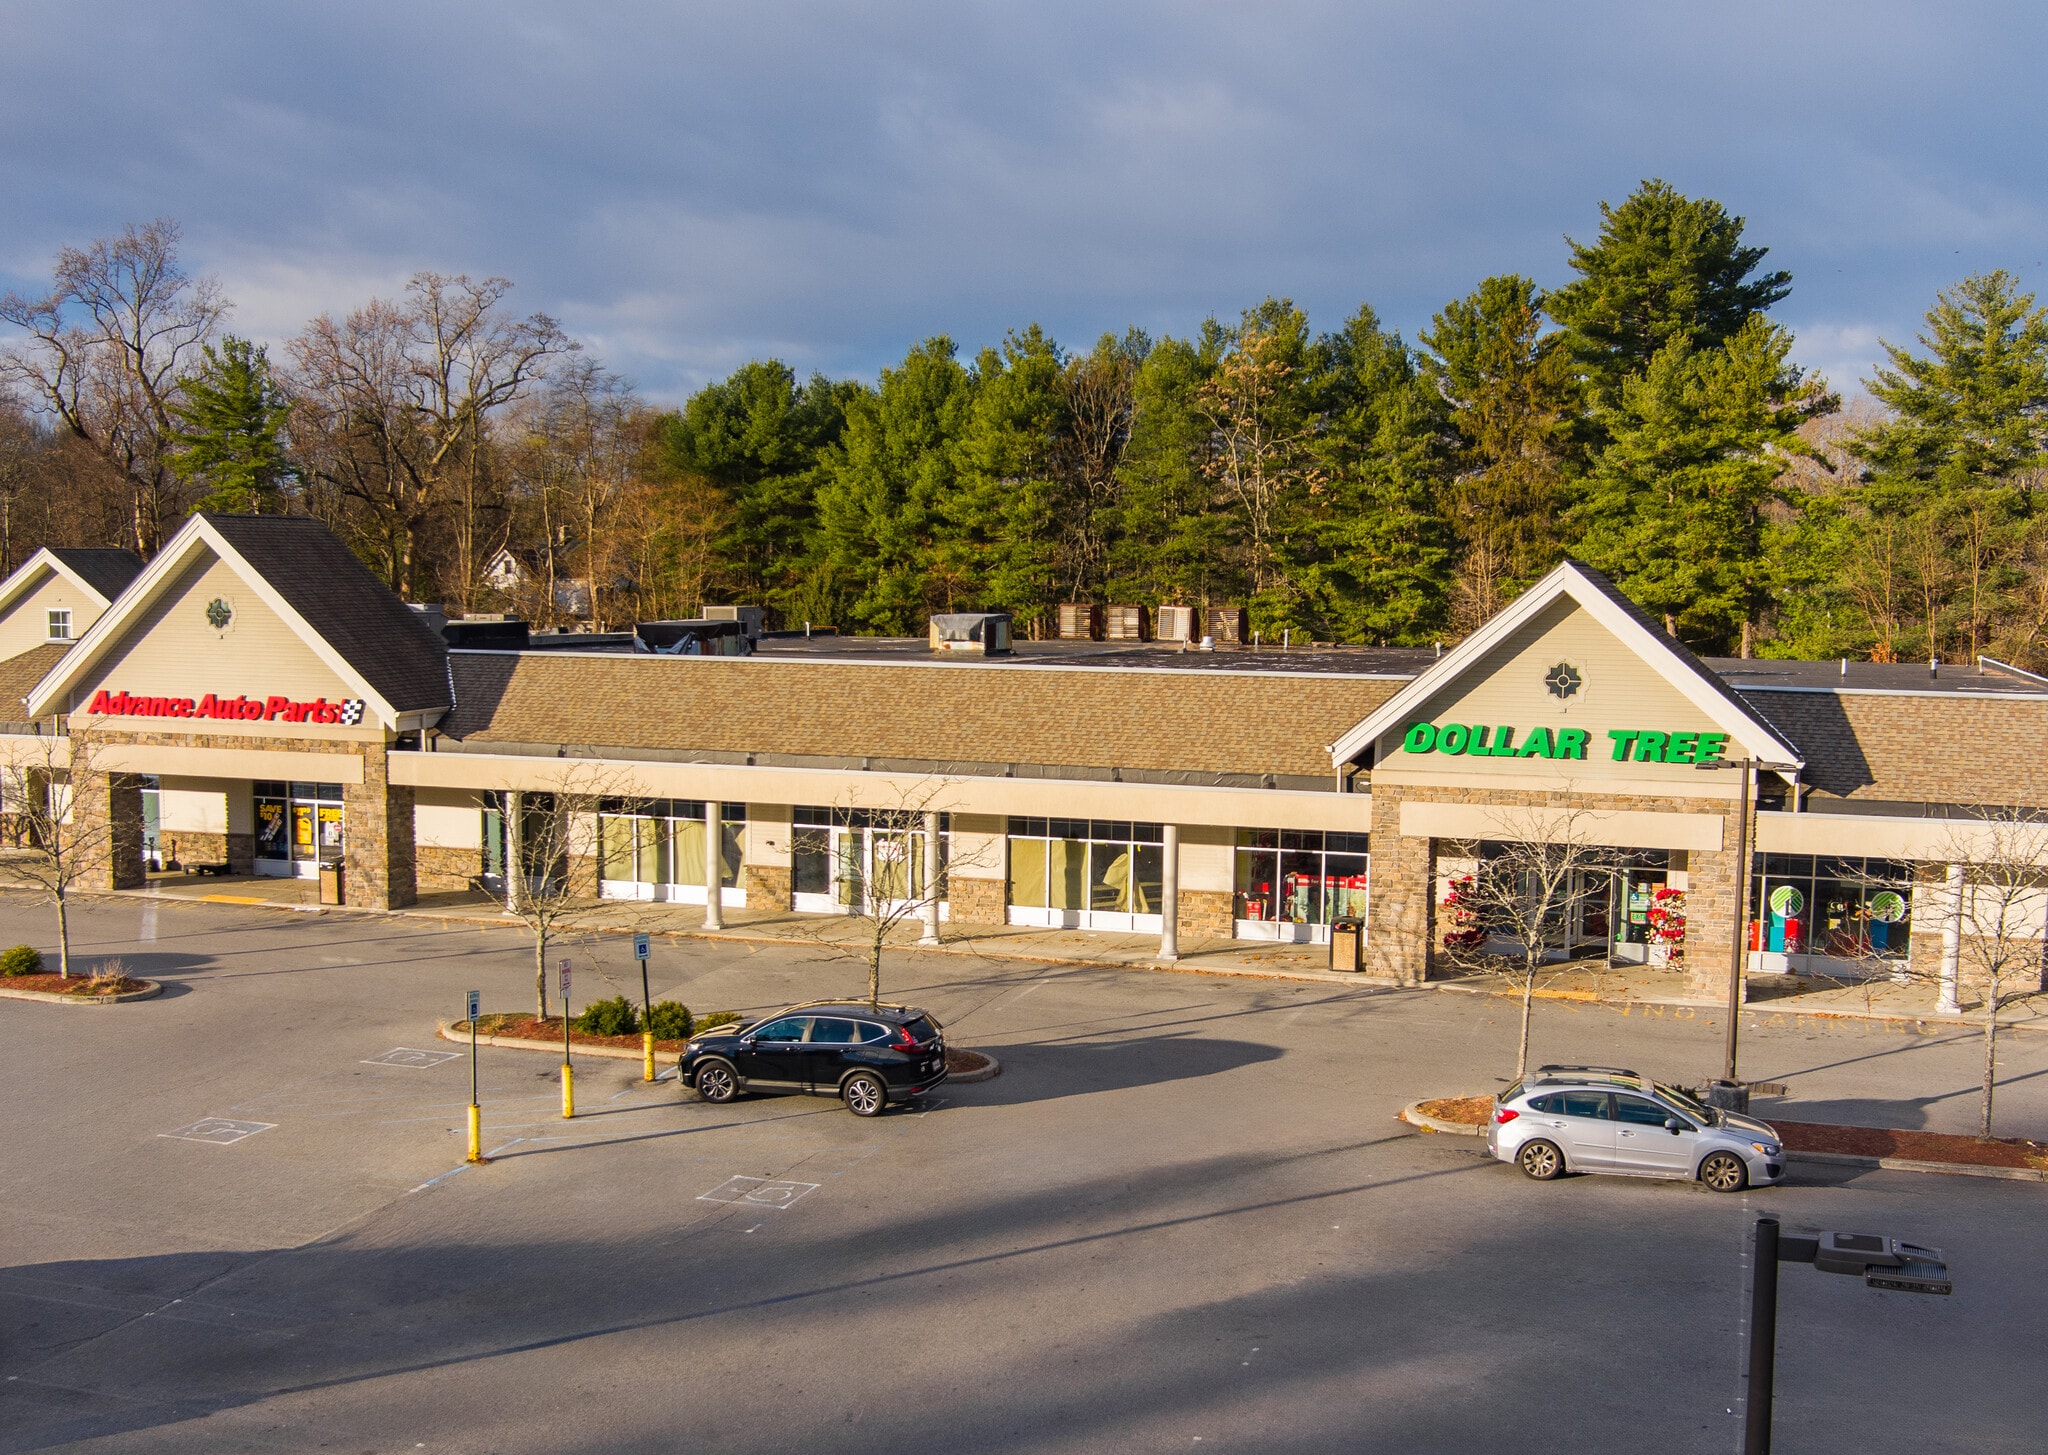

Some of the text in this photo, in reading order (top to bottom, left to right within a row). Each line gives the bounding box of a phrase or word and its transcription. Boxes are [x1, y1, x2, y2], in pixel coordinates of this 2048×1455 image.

[87, 690, 340, 724] Advance Auto Parts
[1403, 722, 1725, 764] DOLLAR TREE
[259, 804, 283, 813] SAVE
[319, 808, 342, 818] FREE
[260, 813, 273, 821] $10
